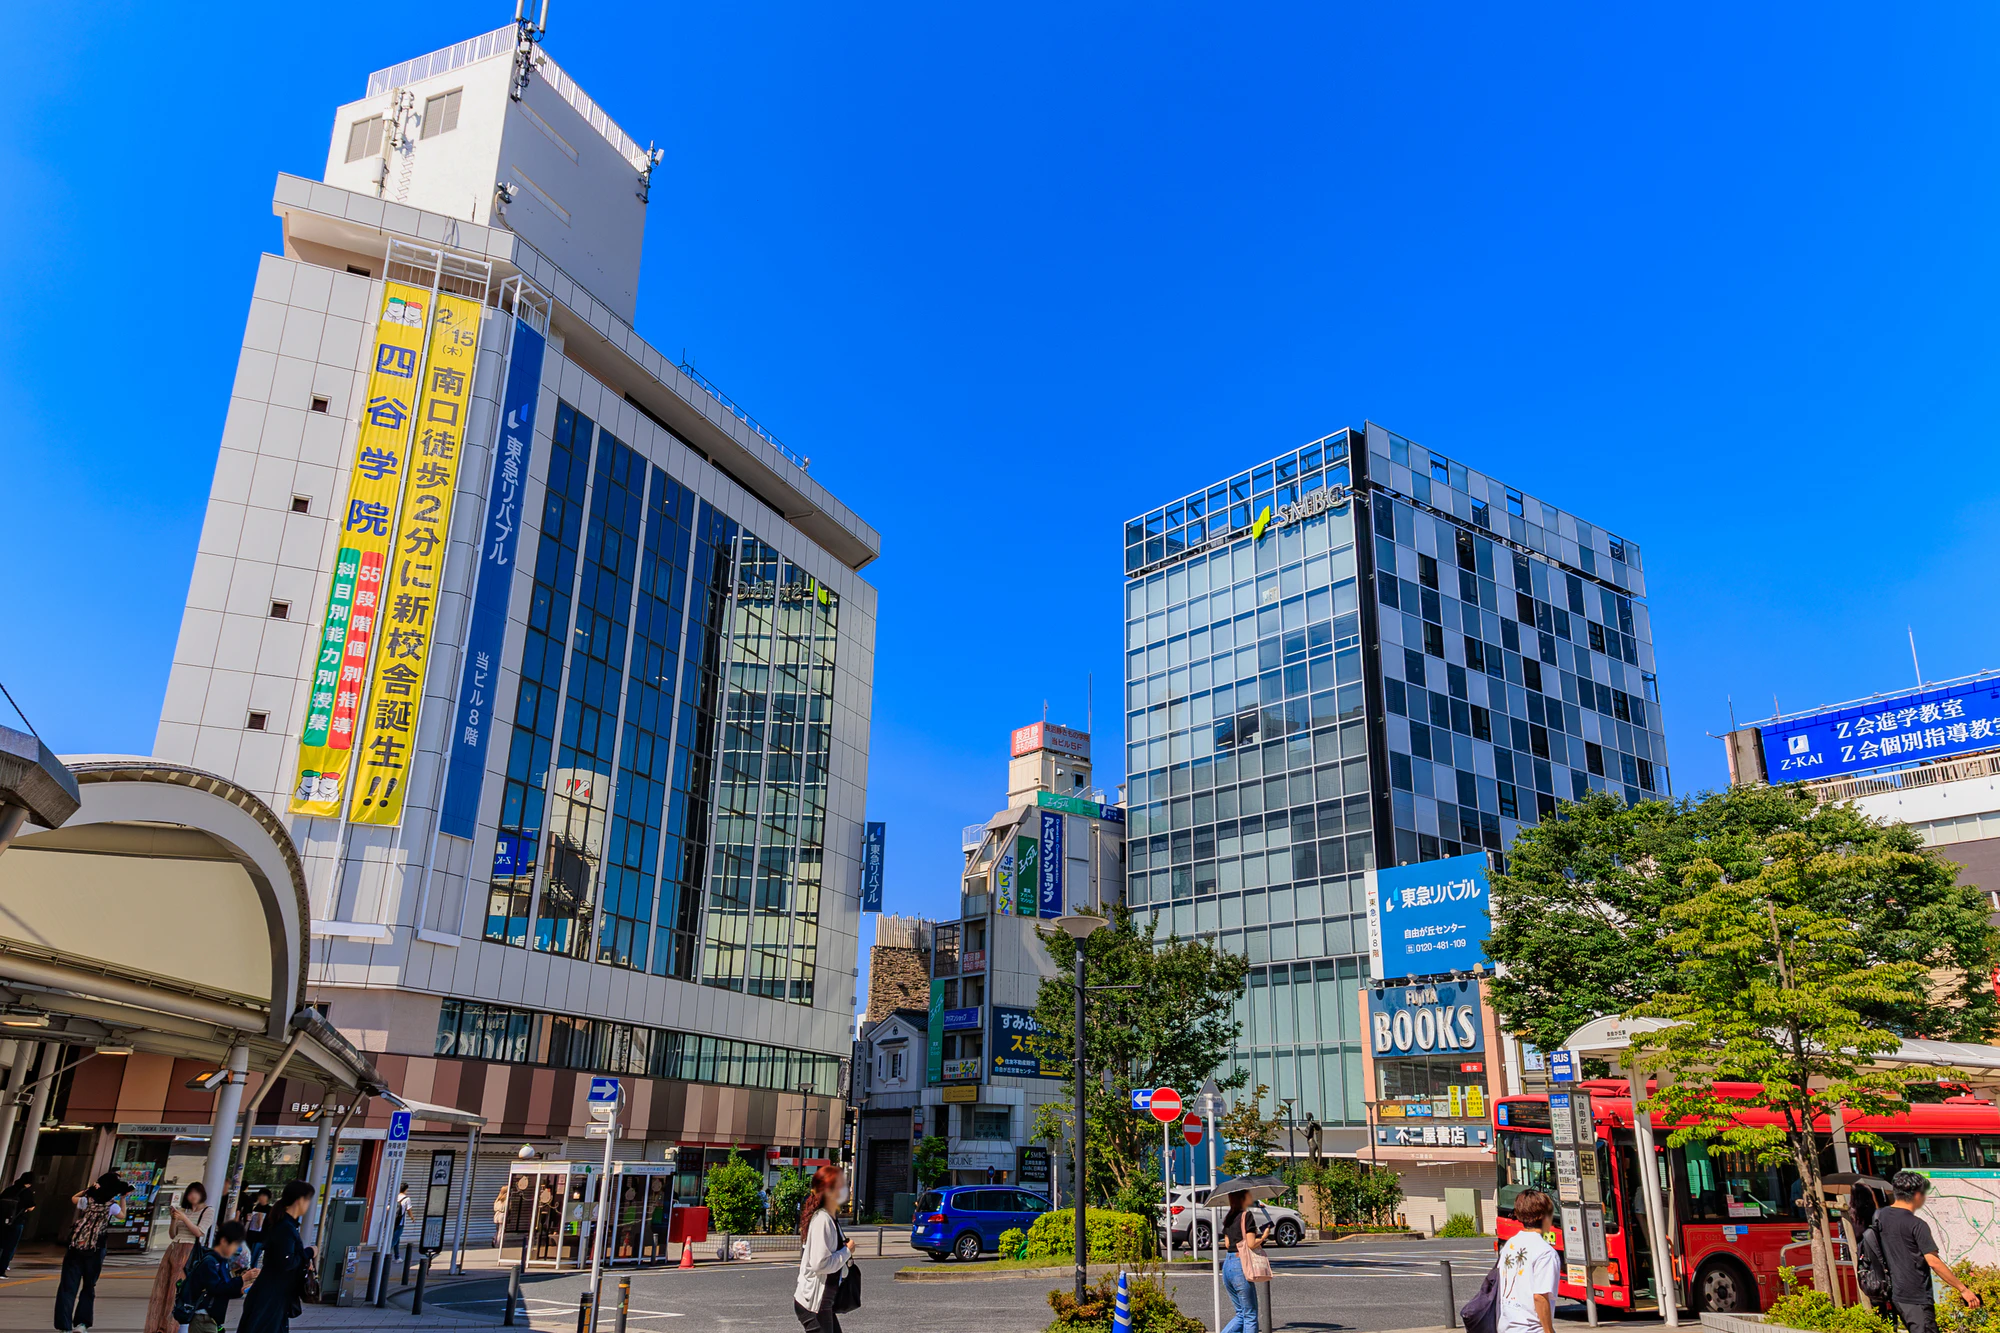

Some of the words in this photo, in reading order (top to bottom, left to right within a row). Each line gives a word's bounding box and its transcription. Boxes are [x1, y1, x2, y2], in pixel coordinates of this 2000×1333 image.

[346, 343, 417, 537] 四谷学院
[489, 434, 525, 566] 東急リバブル
[1277, 483, 1346, 528] SMBC
[307, 561, 357, 732] 科目別能力別授業
[331, 565, 381, 735] 55段階個別指導
[463, 650, 490, 748] 当ビル8階
[1016, 725, 1039, 740] 長沼静
[1045, 723, 1091, 743] 長沼静きもの学院
[1836, 698, 1966, 740] Z会進学教室
[1051, 737, 1083, 751] 当ビル5F
[1780, 752, 1824, 771] Z-KAI
[1043, 797, 1070, 809] エイブル
[867, 843, 881, 904] 東急リバブル
[1004, 855, 1014, 866] 3F
[1018, 844, 1038, 875] エイブル
[1043, 816, 1054, 903] アパマンショップ
[997, 871, 1013, 911] ビッグ
[1401, 879, 1481, 909] 東急リバブル
[1368, 898, 1380, 958] 東急ビル8階
[1404, 923, 1467, 939] 自由が丘センター
[1415, 938, 1467, 953] 0120-481-109
[1405, 987, 1438, 1007] FUJIYA
[1373, 1005, 1476, 1052] BOOKS
[1552, 1053, 1569, 1063] BUS
[291, 1102, 362, 1115] 自由が急ル
[1578, 1102, 1589, 1141] 自由が丘駅
[1394, 1126, 1466, 1145] 不二屋書店
